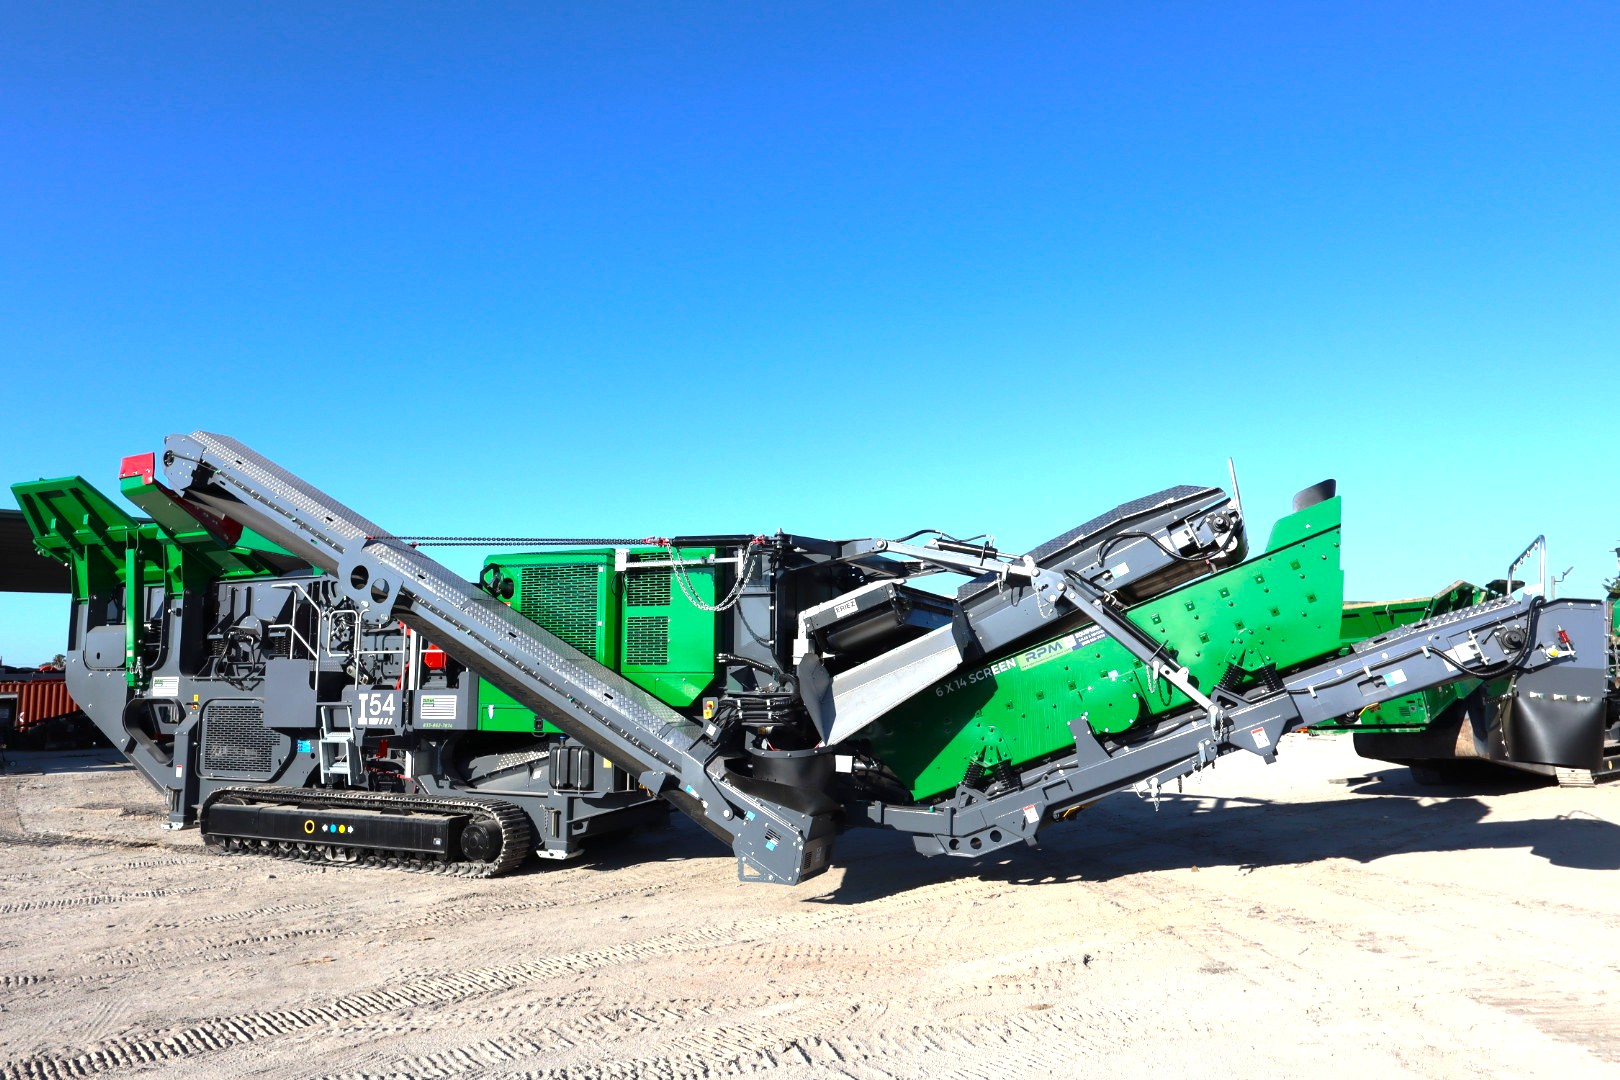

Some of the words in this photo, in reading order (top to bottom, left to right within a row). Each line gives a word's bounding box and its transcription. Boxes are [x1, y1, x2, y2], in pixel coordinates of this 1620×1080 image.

[1025, 641, 1063, 663] RPM
[935, 686, 944, 697] 6
[945, 682, 954, 693] X
[954, 677, 967, 689] 14
[968, 657, 1017, 684] SCREEN
